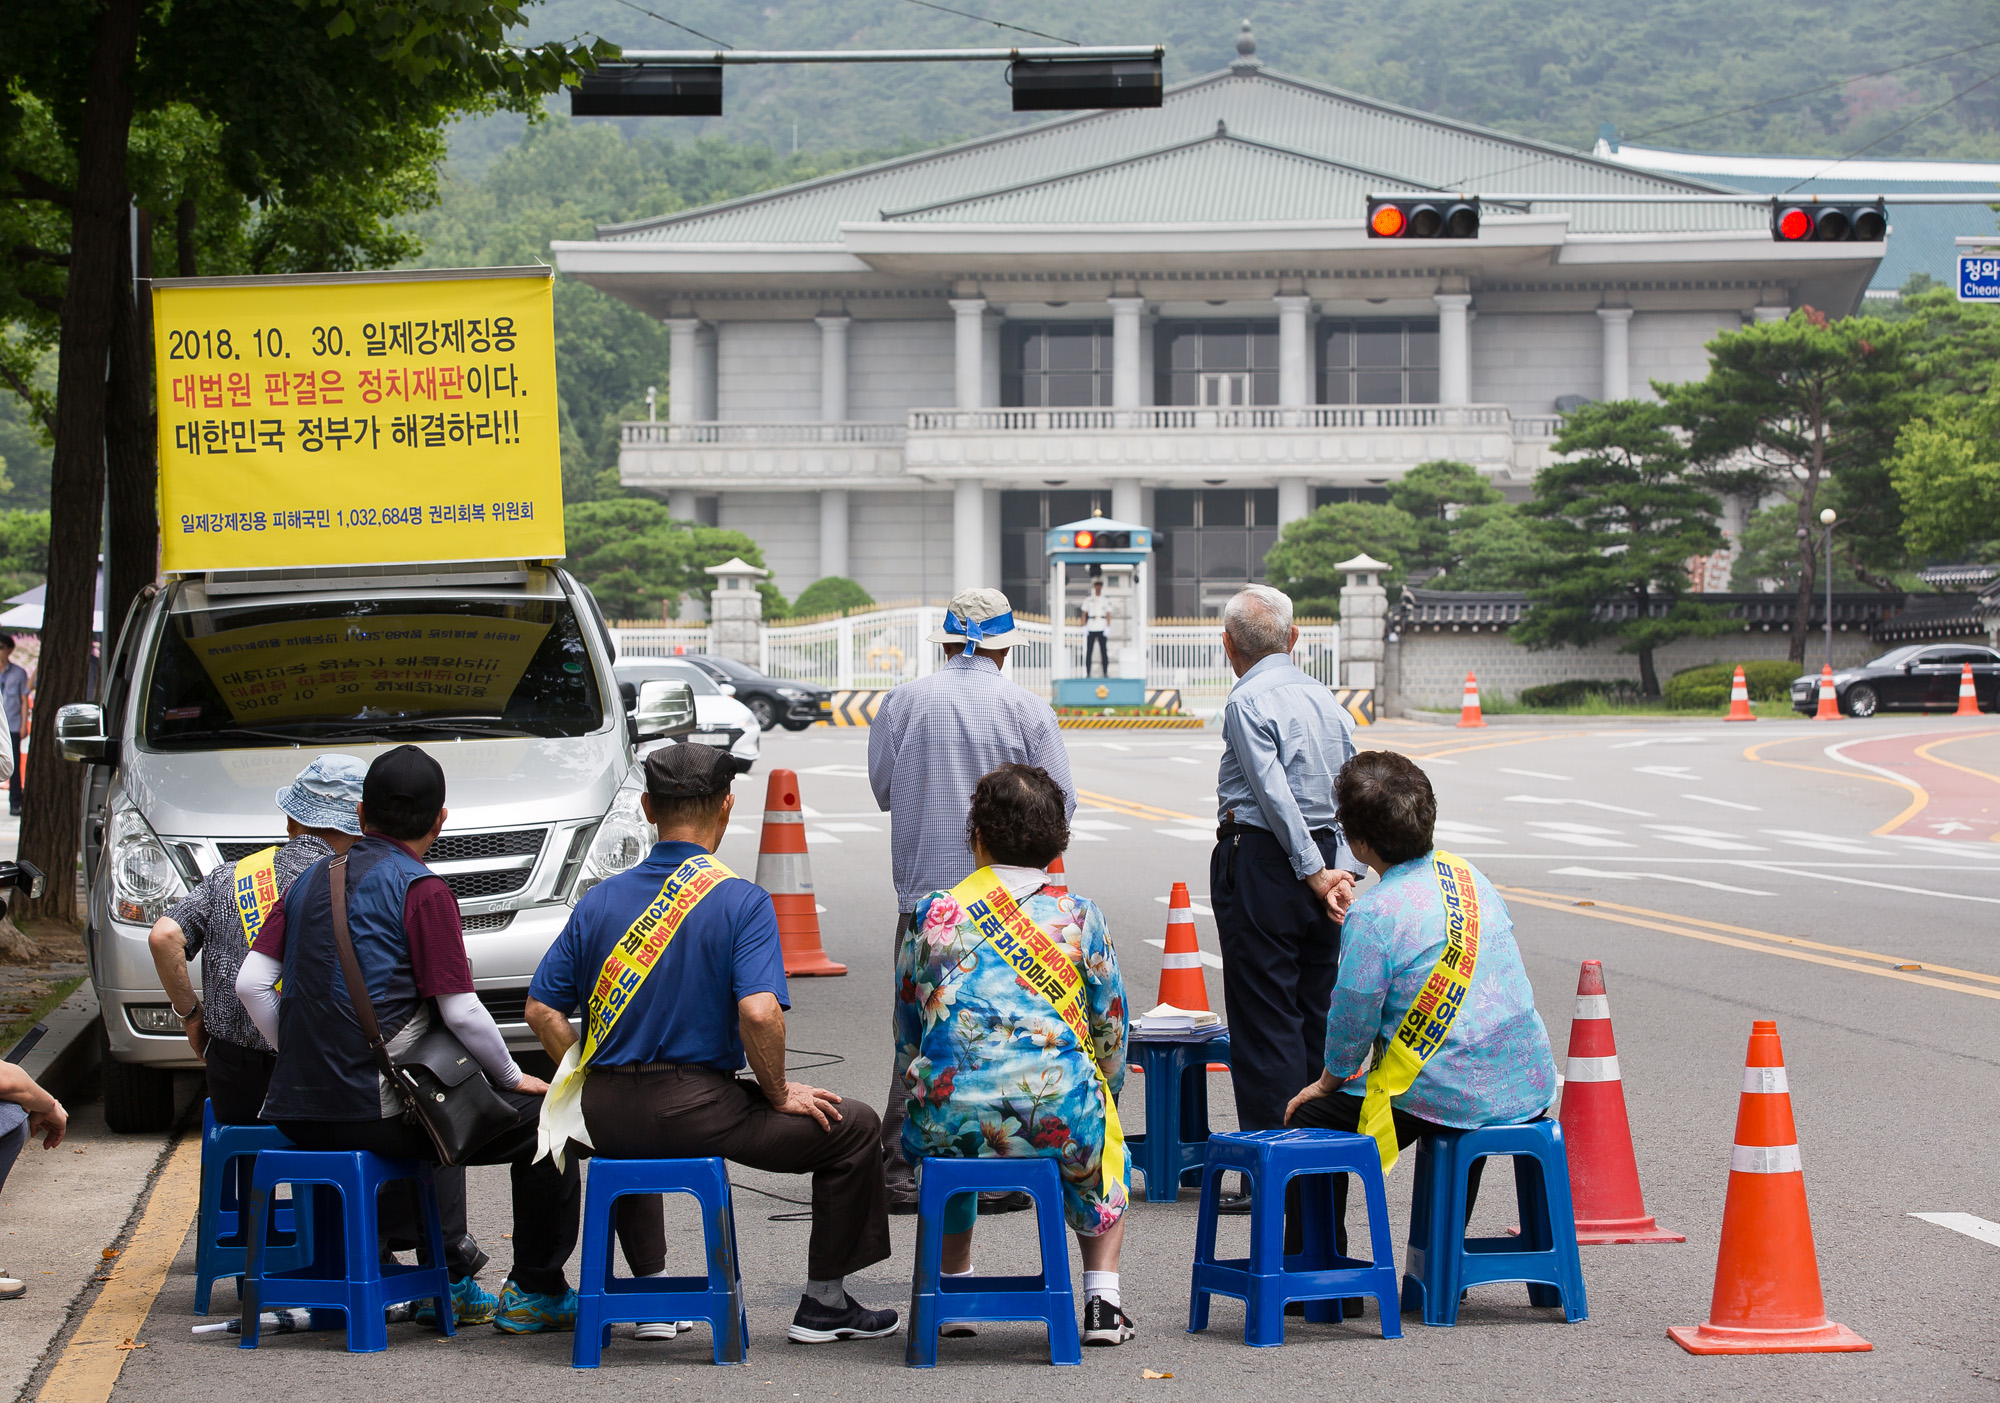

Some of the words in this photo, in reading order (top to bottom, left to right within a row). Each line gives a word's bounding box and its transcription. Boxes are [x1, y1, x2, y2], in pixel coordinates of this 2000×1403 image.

[1965, 282, 2000, 296] Cheon
[169, 329, 240, 360] 2018.
[254, 328, 290, 358] 10.
[312, 326, 350, 356] 30.
[363, 317, 517, 356] 일제강제징용
[173, 373, 251, 408] 대법원
[265, 370, 344, 406] 판결은
[358, 363, 527, 403] 정치재판이다.
[176, 419, 285, 455] 대한민국
[298, 415, 380, 452] 정부가
[391, 410, 519, 448] 해결하라!!
[181, 512, 267, 533] 일제강제징용
[273, 509, 330, 529] 피해국민
[337, 506, 422, 528] 1,032,684명
[429, 504, 485, 523] 권리회복
[492, 502, 533, 521] 위원회
[488, 900, 514, 912] Gold
[635, 868, 731, 969] 일제강제동원
[1436, 860, 1466, 971] 피해보상문제
[1453, 866, 1479, 980] 일제강제동원
[986, 886, 1079, 989] 일제강제동원
[1398, 971, 1450, 1049] 해결하라
